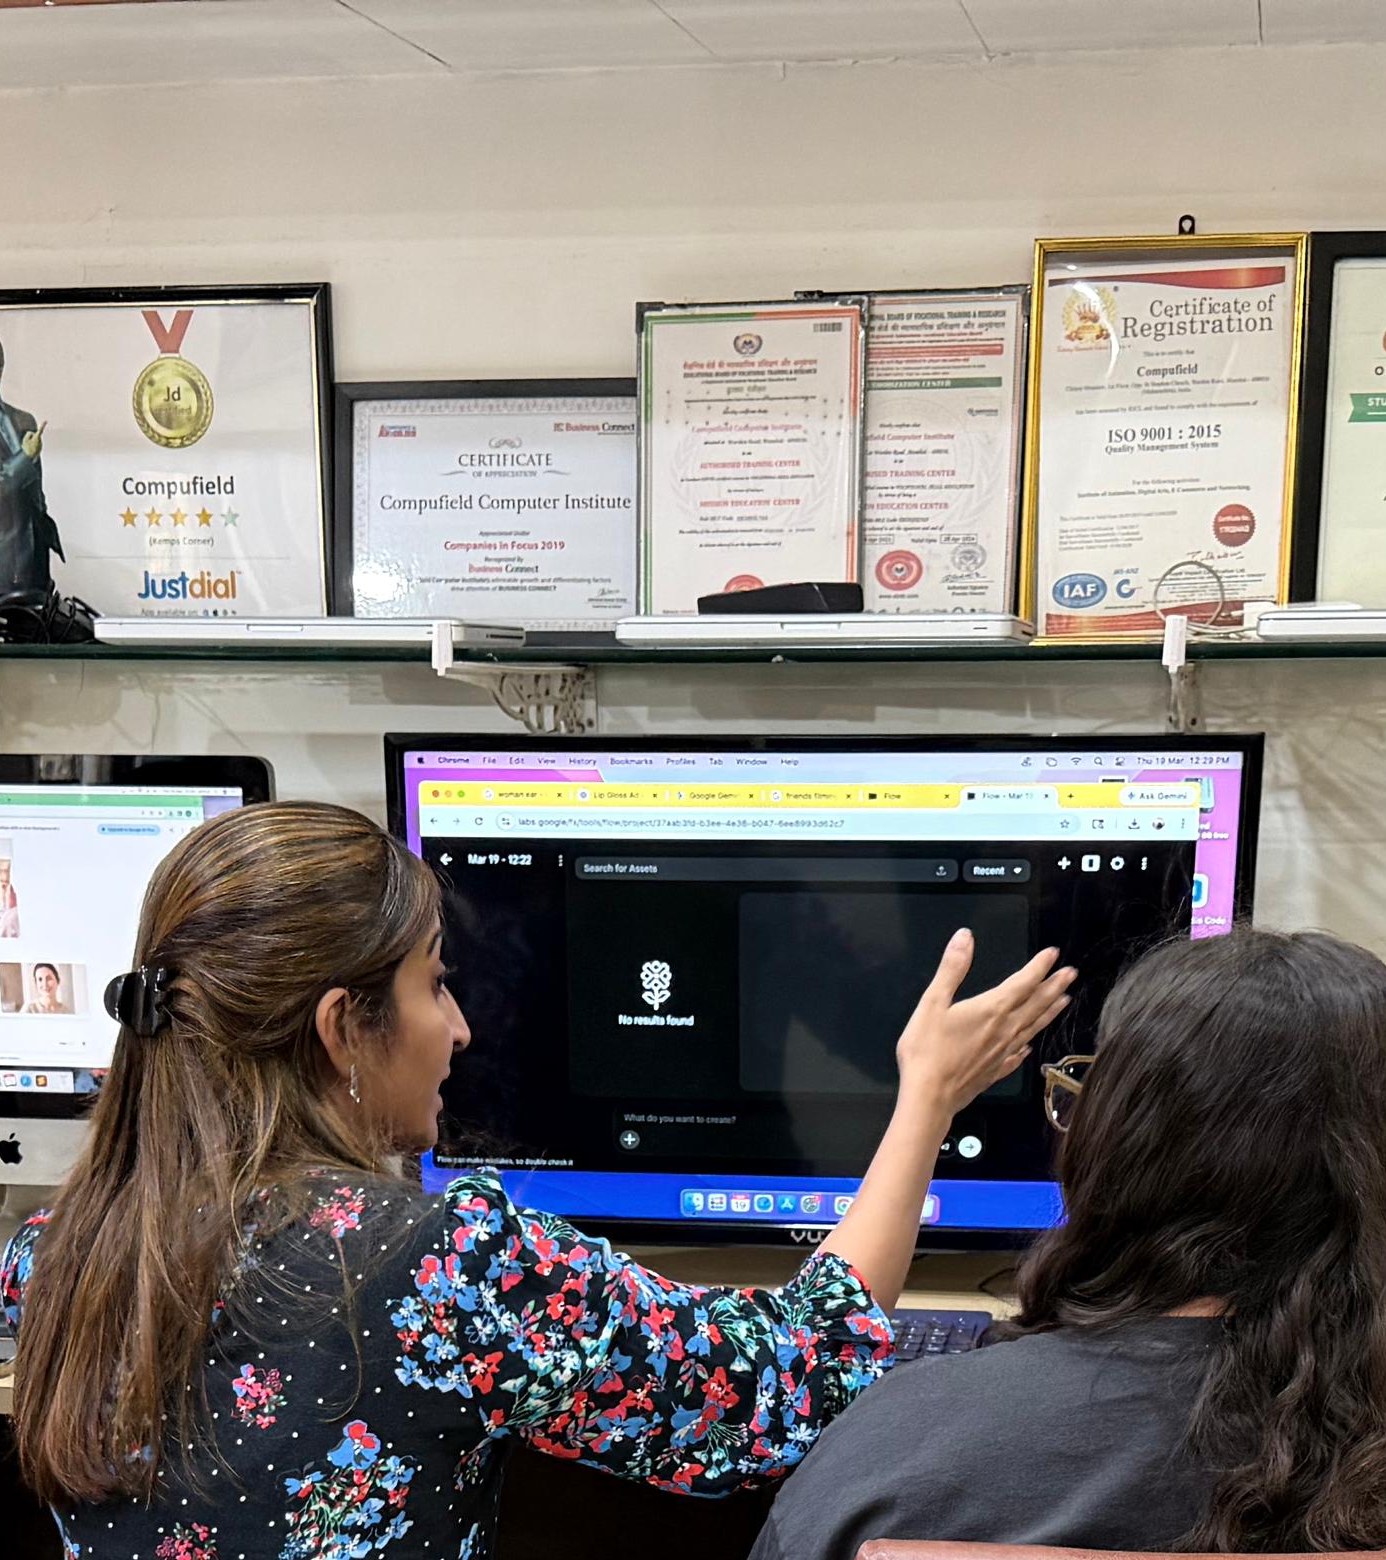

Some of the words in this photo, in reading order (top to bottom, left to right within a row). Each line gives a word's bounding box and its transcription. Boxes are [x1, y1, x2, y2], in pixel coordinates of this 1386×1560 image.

[1150, 296, 1251, 318] Certificate
[1256, 294, 1276, 312] of
[1122, 316, 1274, 341] Registration
[1137, 364, 1198, 378] Compufield
[164, 386, 181, 402] Jd
[602, 422, 635, 433] Connect
[1108, 429, 1136, 444] ISO
[1140, 427, 1173, 442] 9001
[1178, 429, 1184, 441] :
[1188, 424, 1222, 439] 2015
[1105, 444, 1135, 455] Quality
[1137, 442, 1188, 453] Management
[1190, 440, 1219, 452] System
[458, 453, 552, 467] CERTIFICATE
[122, 476, 234, 499] Compufield
[380, 495, 473, 515] Compufield
[478, 496, 560, 515] Computer
[564, 494, 632, 509] Institute
[444, 541, 497, 552] Companies
[511, 541, 539, 550] Focus
[541, 541, 565, 550] 2019
[138, 570, 237, 600] Justdial
[1064, 584, 1098, 599] IAF
[438, 756, 470, 765] Chrome
[509, 757, 525, 765] Edit
[537, 757, 556, 765] View
[569, 758, 597, 767] History
[610, 757, 653, 766] Bookmarks
[666, 758, 696, 766] Profiles
[709, 758, 723, 766] Tab
[736, 758, 768, 766] Window
[780, 758, 799, 767] Help
[1137, 757, 1153, 765] Thu
[1168, 757, 1184, 765] Mar
[689, 792, 716, 801] Google
[1139, 792, 1154, 801] Ask
[1158, 792, 1188, 801] Gemini
[468, 854, 487, 865] Mar
[489, 854, 499, 865] 19
[584, 864, 613, 874] Search
[614, 864, 627, 873] for
[629, 864, 658, 874] Assets
[973, 866, 1005, 876] Recent
[618, 1014, 632, 1025] No
[634, 1015, 666, 1026] results
[667, 1014, 694, 1026] found
[624, 1114, 645, 1122] What
[647, 1114, 658, 1122] do
